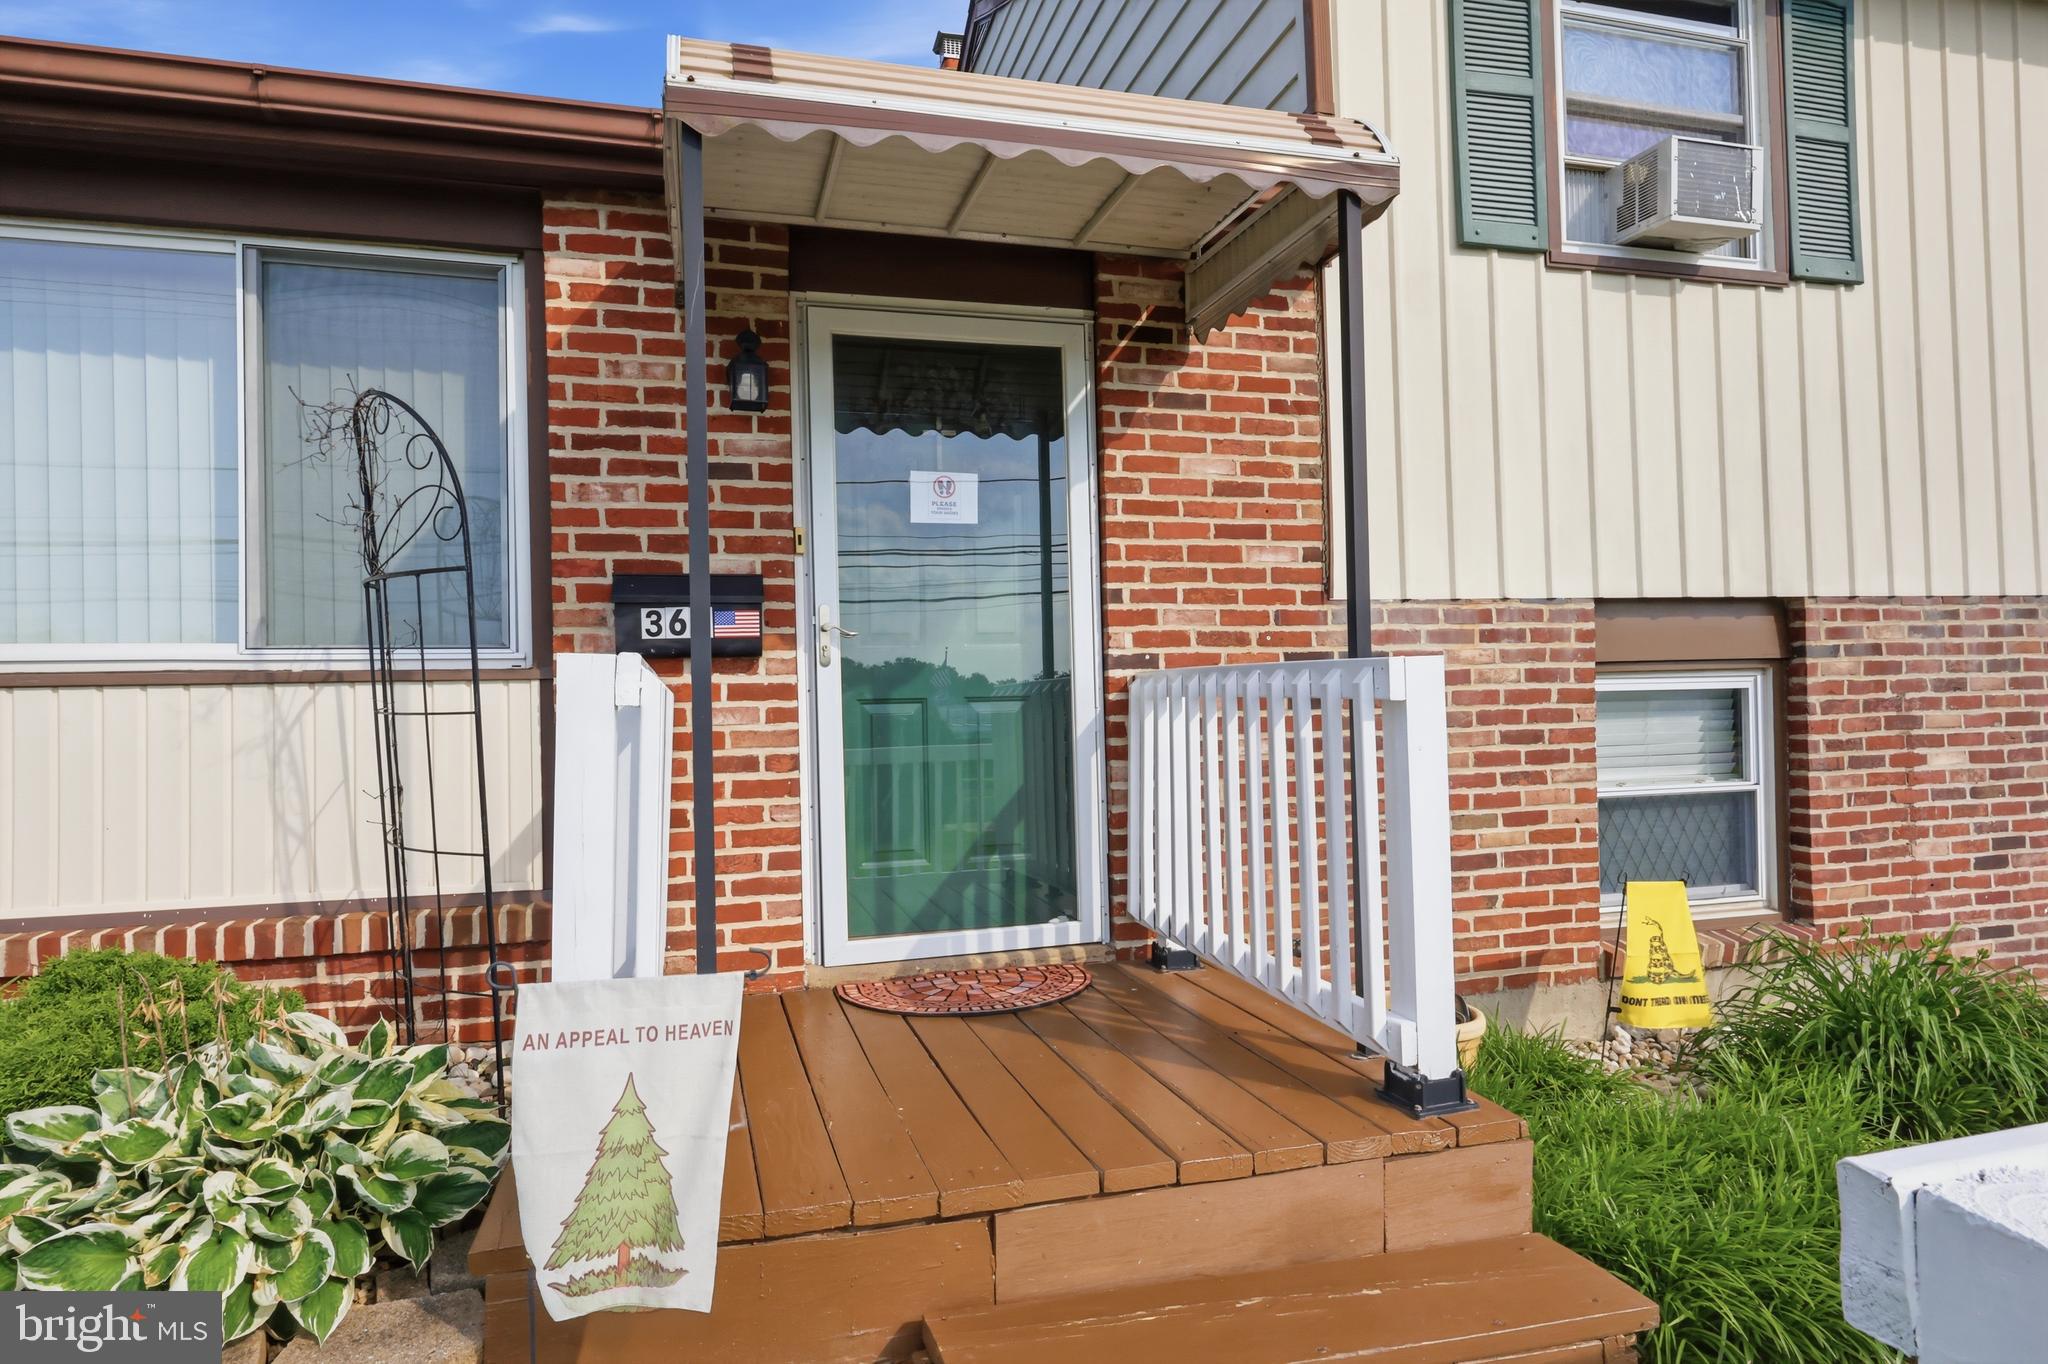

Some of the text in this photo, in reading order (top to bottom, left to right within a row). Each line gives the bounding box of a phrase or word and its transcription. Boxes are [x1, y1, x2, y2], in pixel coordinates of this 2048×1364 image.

[645, 608, 690, 638] 36
[1621, 995, 1648, 1008] DONT
[522, 1019, 734, 1052] AN APPEAL TO HEAVEN
